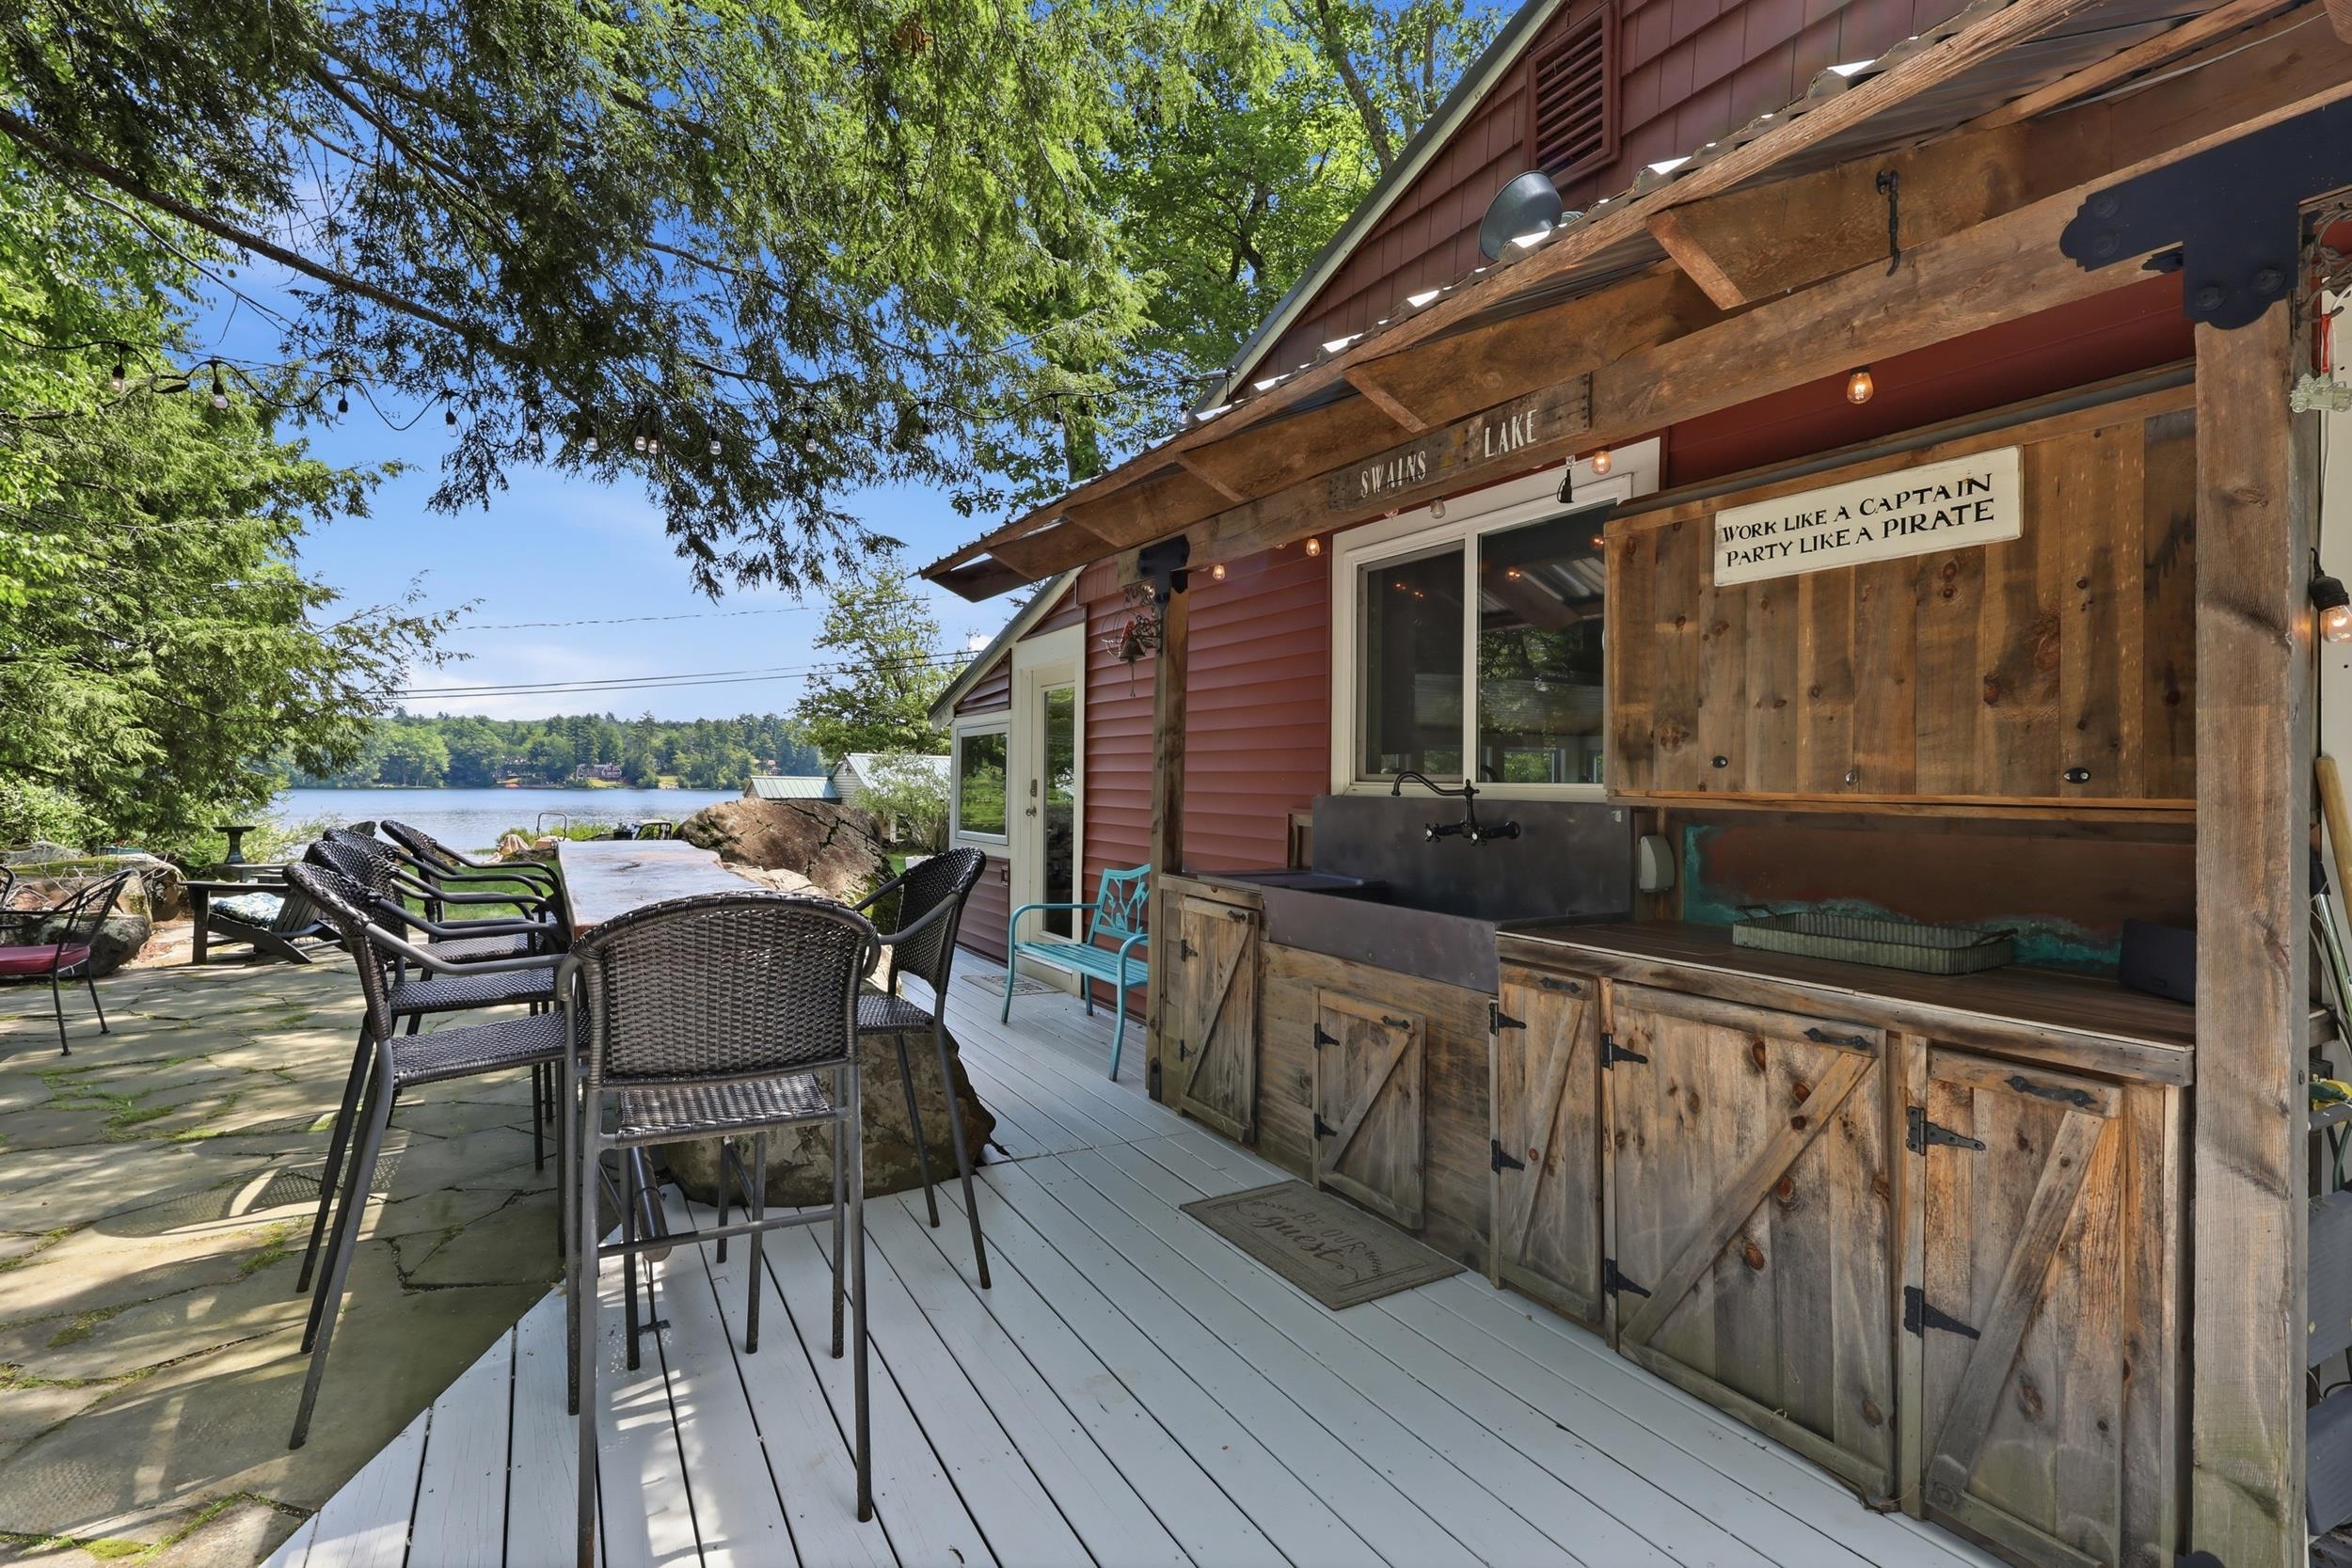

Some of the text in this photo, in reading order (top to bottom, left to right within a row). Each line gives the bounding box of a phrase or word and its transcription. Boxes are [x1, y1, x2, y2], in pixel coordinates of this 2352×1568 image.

[1361, 408, 1537, 498] SWAINS LAKE
[1722, 472, 1993, 543] WORK LIKE A CAPTAIN
[1725, 498, 1994, 567] PARTY LIKE A PIRATE
[1249, 1215, 1344, 1267] guest
[1321, 1228, 1367, 1254] OUR
